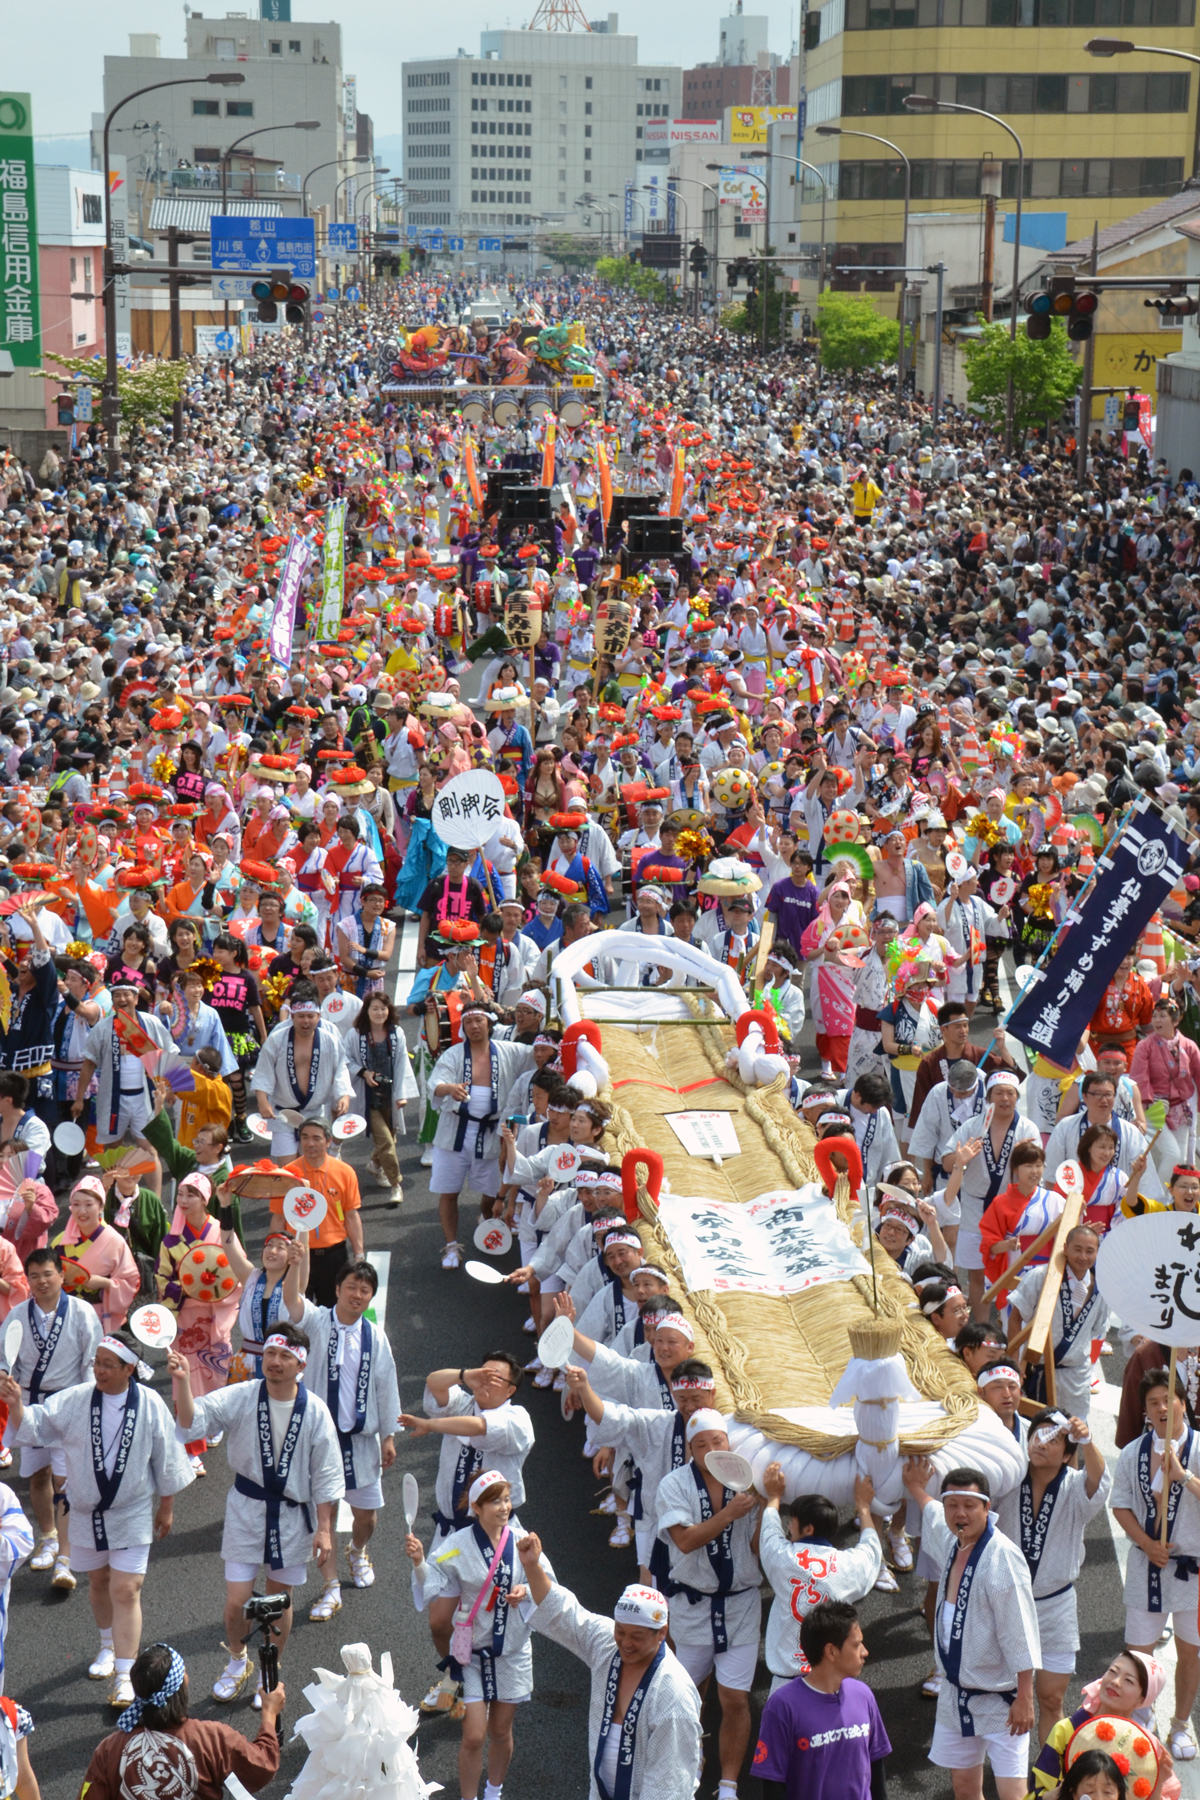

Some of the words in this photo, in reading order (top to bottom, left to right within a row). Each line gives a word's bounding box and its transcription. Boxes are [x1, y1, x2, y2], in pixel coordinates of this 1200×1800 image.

[670, 131, 719, 141] NISSAN
[0, 159, 33, 344] 福島信用金庫
[218, 241, 243, 252] 川俣
[250, 219, 276, 231] 郡山
[260, 251, 266, 259] 4
[277, 242, 312, 254] 福島市街
[300, 263, 310, 271] 13
[505, 593, 531, 646] 青森市
[603, 603, 630, 653] 青森市
[211, 998, 244, 1011] DANCE
[691, 1210, 768, 1278] 家内安全
[1150, 1263, 1174, 1330] まつり
[92, 1406, 104, 1472] 福島わらじまつり
[115, 1408, 136, 1473] 福島わらじまつり
[258, 1401, 273, 1467] 福島わらじまつり
[277, 1412, 302, 1479] 福島わらじまつり
[952, 1565, 973, 1640] 福島わらじまつり
[600, 1656, 621, 1737] 福島わらじまつり
[621, 1688, 644, 1766] 福島わらじまつり
